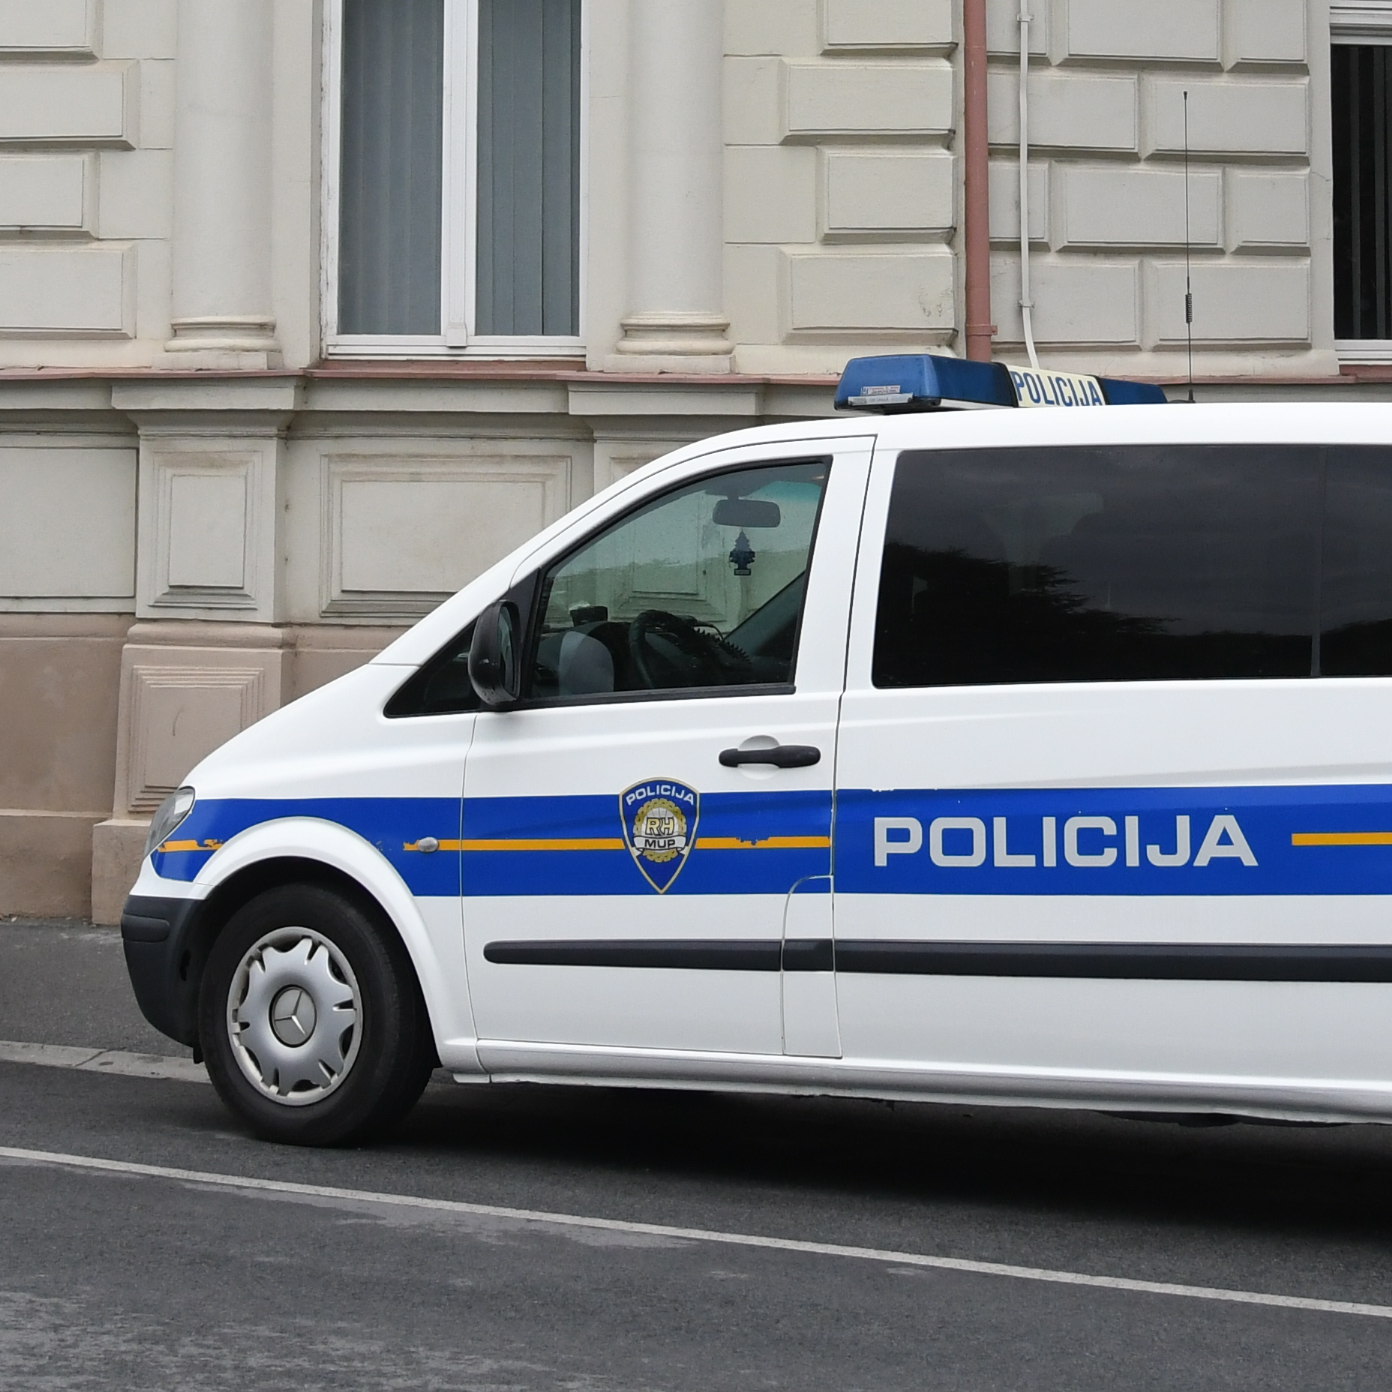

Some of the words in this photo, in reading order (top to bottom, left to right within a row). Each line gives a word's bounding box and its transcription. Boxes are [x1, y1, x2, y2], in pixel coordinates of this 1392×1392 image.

[1010, 371, 1103, 407] POLICIJA
[625, 784, 695, 806] POLICIJA
[645, 816, 676, 837] RH
[644, 839, 676, 849] MUP
[874, 814, 1259, 868] POLICIJA
